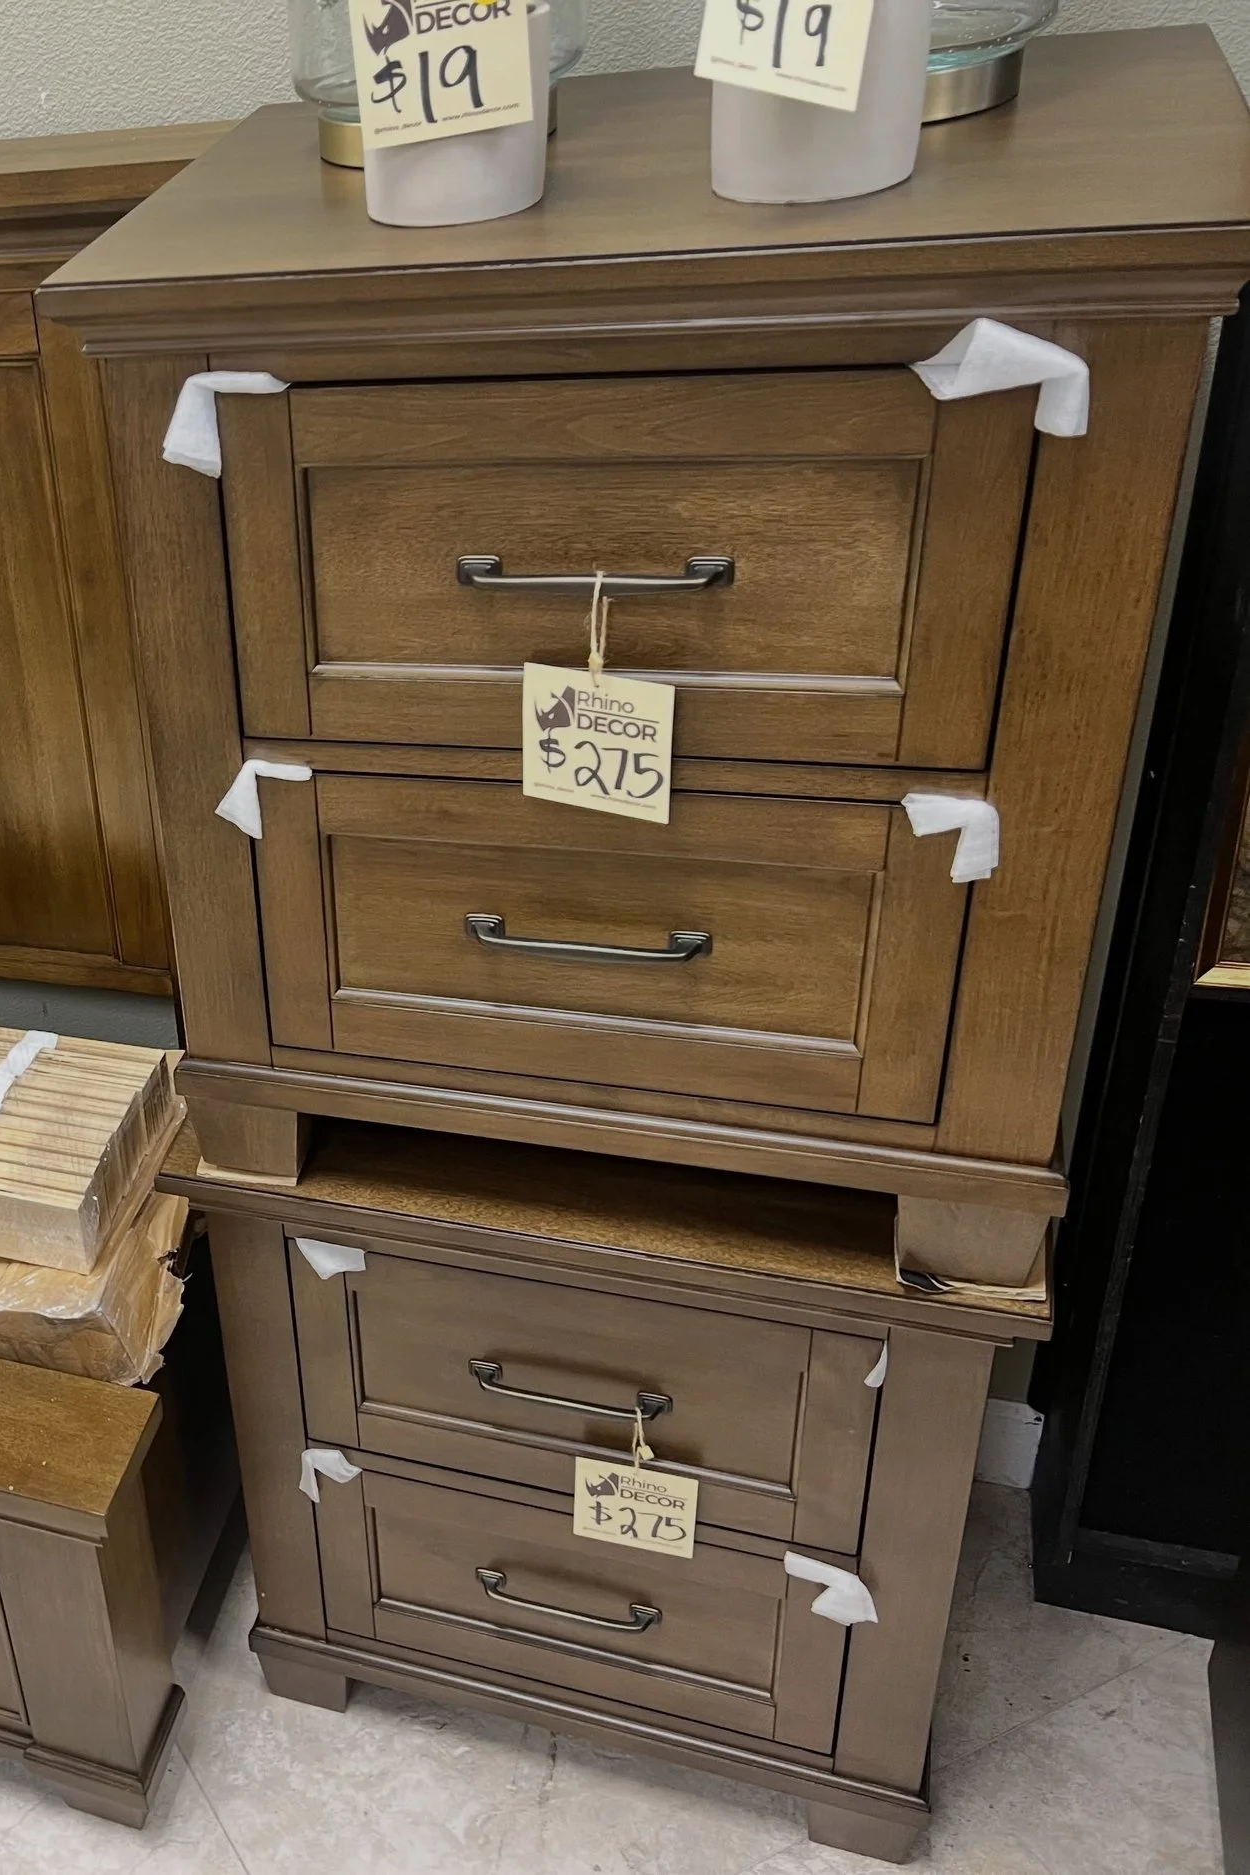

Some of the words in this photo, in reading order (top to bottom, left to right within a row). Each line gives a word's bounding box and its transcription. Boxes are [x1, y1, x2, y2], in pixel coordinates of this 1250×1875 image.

[415, 0, 511, 34] DECOR
[371, 45, 485, 123] $19
[577, 690, 635, 714] Rhino
[577, 713, 657, 743] DECOR
[539, 730, 664, 799] $275
[620, 1476, 668, 1493] Rhino
[620, 1488, 686, 1511] DECOR
